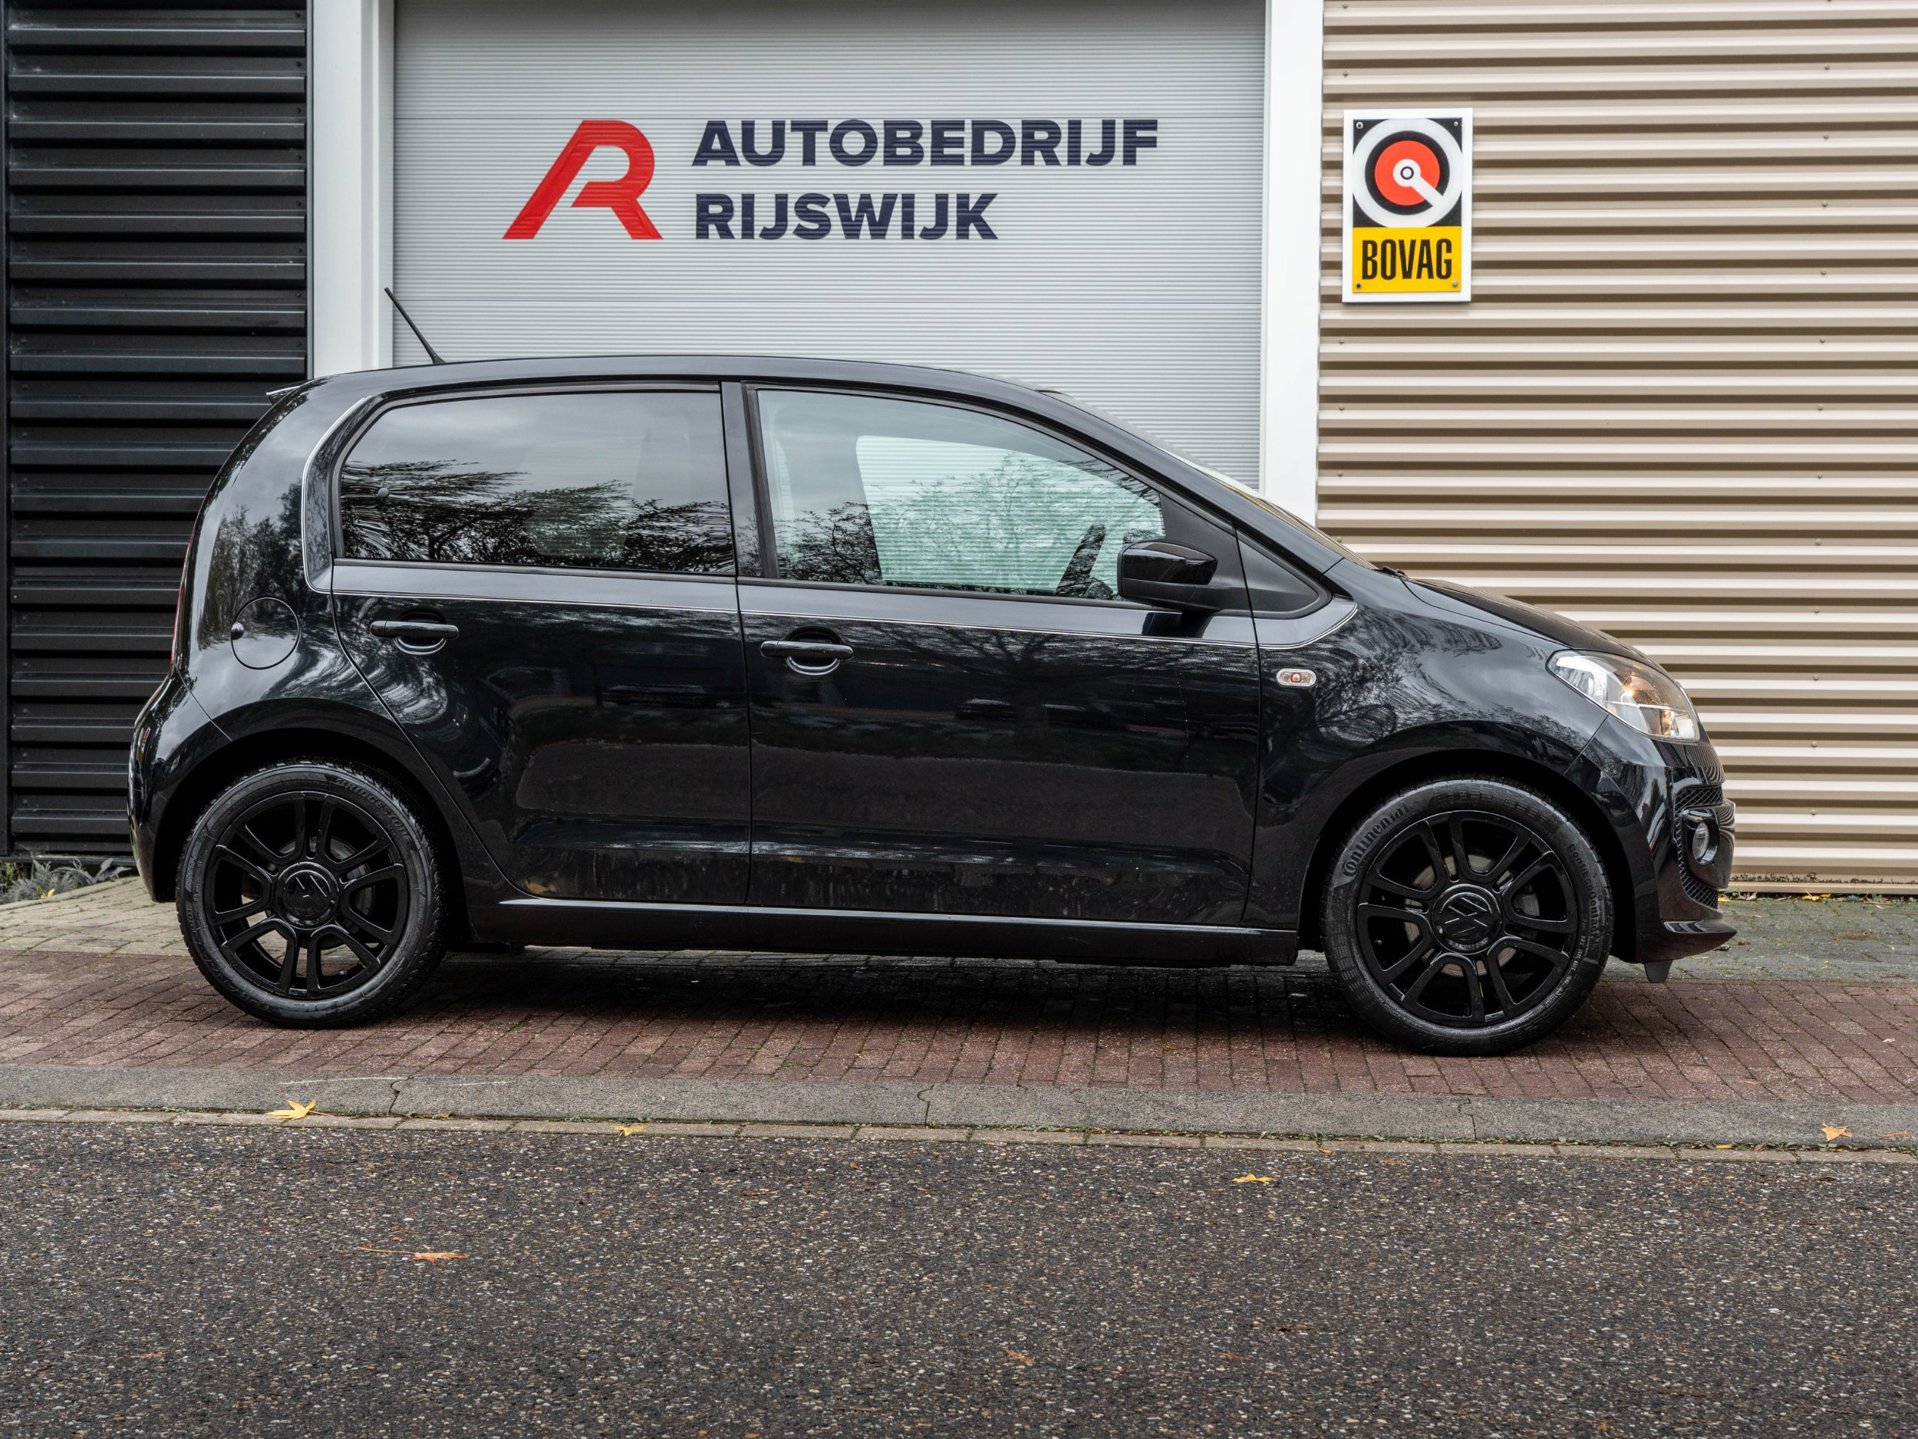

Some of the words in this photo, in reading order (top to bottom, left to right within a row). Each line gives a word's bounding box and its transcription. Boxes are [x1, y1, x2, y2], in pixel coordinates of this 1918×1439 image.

[691, 119, 1158, 167] AUTOBEDRIJF
[695, 192, 999, 240] RIJSWIJK
[1361, 238, 1453, 281] BOVAG
